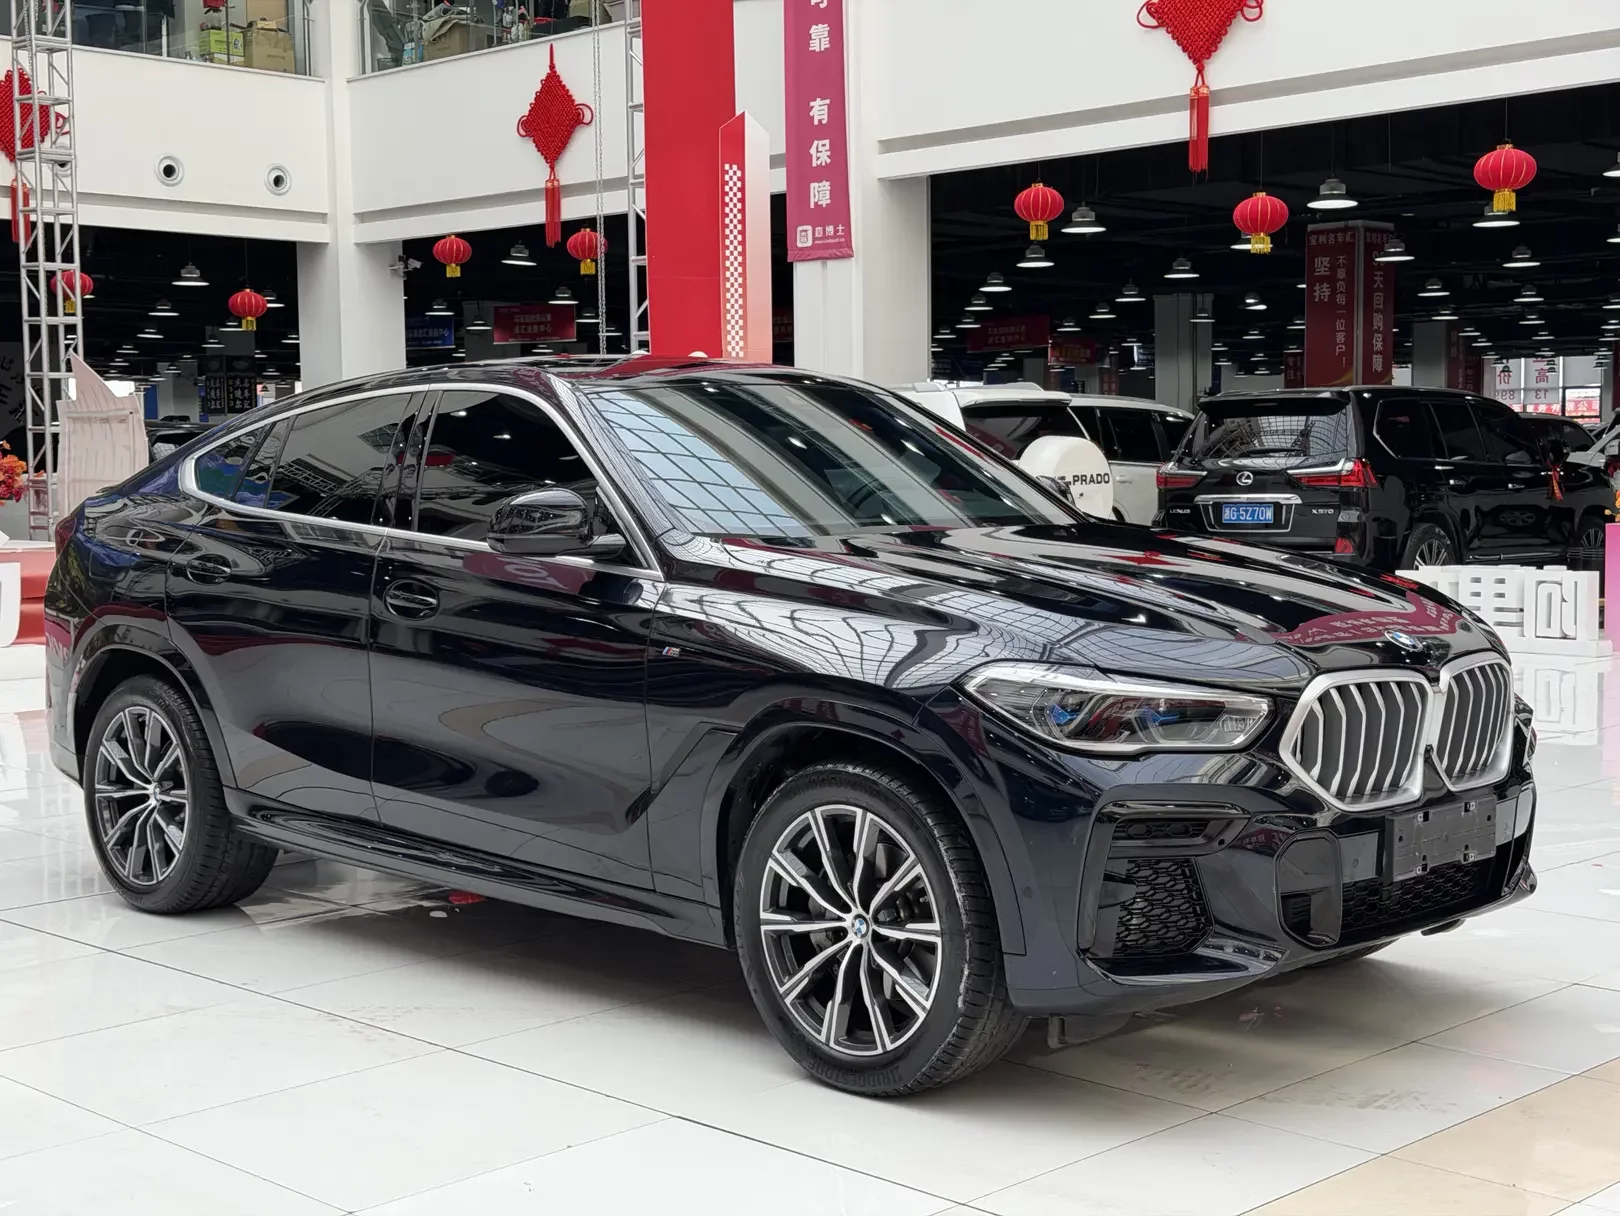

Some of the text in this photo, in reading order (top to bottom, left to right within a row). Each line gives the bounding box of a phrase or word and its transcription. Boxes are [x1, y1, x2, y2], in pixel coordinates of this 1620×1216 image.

[809, 97, 831, 209] 有保障
[1313, 256, 1332, 302] 坚持
[1072, 472, 1110, 486] PRADO
